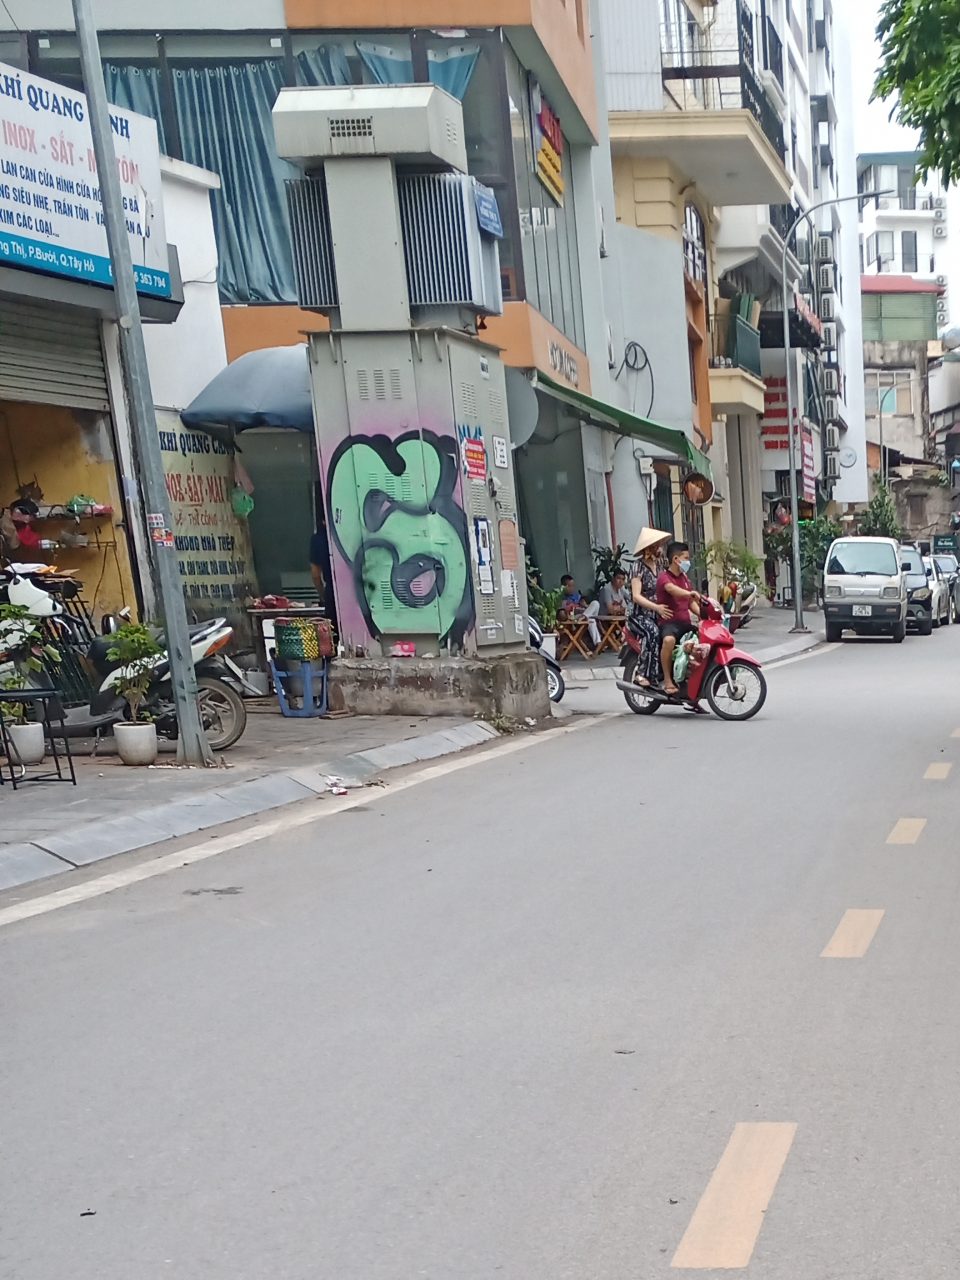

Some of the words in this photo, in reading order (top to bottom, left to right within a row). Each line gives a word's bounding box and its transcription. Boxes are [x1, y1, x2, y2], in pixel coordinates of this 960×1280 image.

[27, 84, 84, 122] QUANG
[2, 119, 38, 154] INOX
[1, 159, 18, 177] LAN
[20, 165, 37, 183] CAN
[159, 428, 178, 452] KHÍ
[179, 433, 210, 457] QUANG
